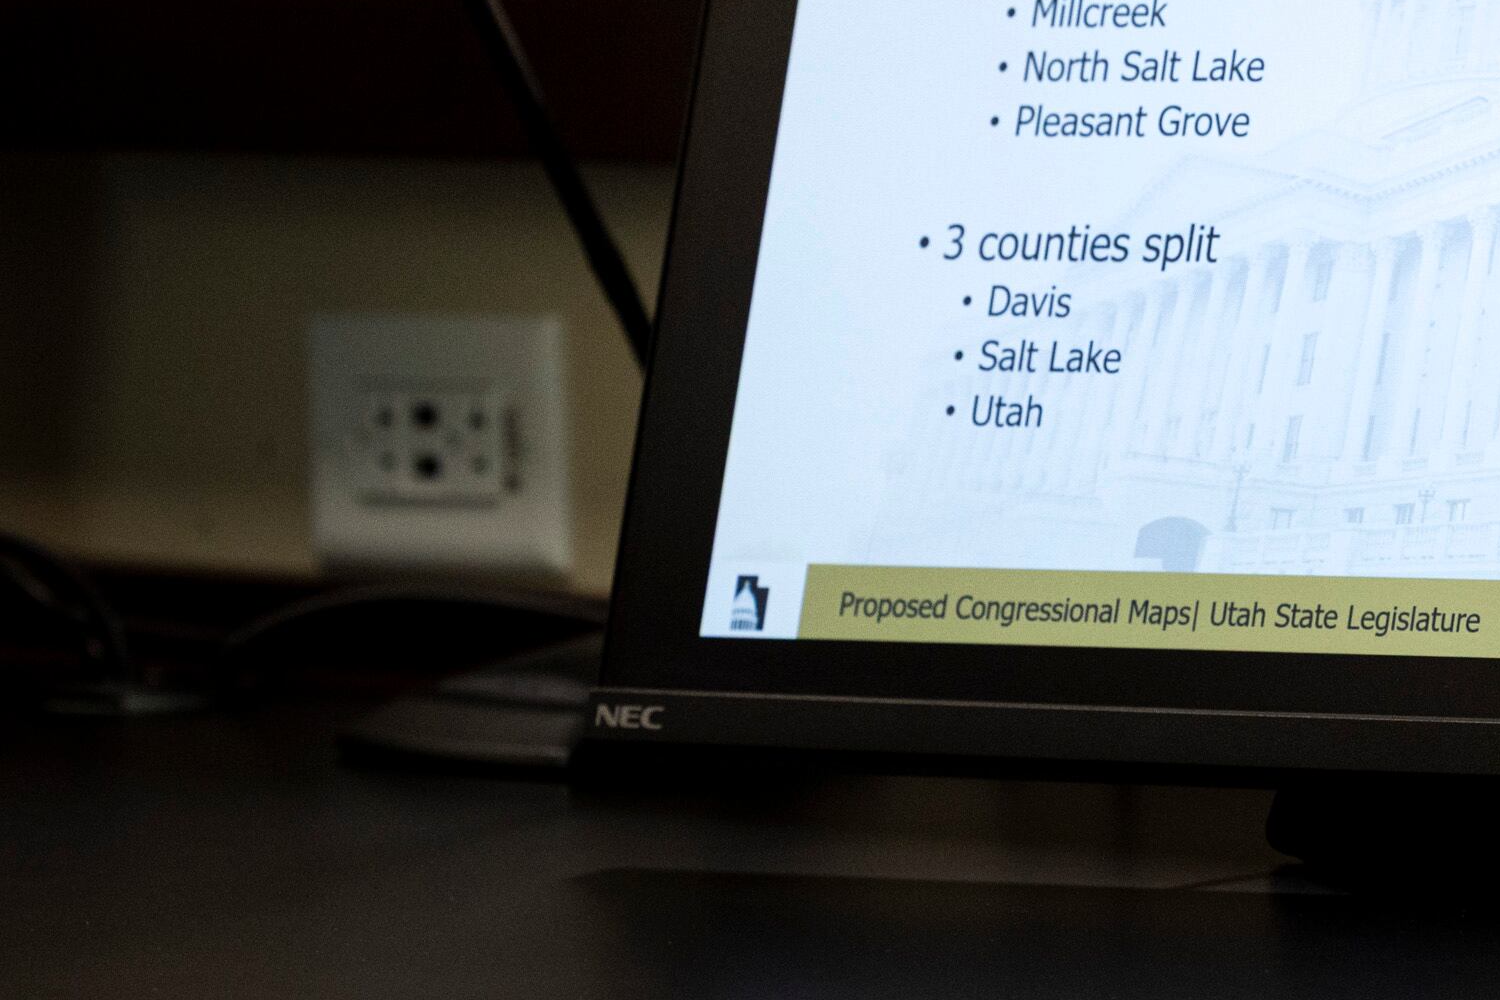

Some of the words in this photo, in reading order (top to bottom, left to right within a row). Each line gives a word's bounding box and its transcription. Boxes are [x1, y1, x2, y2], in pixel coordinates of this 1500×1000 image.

[1022, 50, 1109, 82] North
[1120, 50, 1181, 82] Salt
[1192, 49, 1265, 82] Lake
[1015, 105, 1147, 138] Pleasant
[1158, 105, 1250, 138] Grove
[943, 223, 966, 261] 3
[978, 224, 1131, 263] counties
[1142, 223, 1220, 271] split
[987, 285, 1072, 318] Davis
[978, 340, 1039, 374] Salt
[1048, 340, 1122, 374] Lake
[970, 394, 1044, 428] Utah
[839, 592, 948, 623] Proposed
[955, 594, 1120, 627] Congressional
[1209, 601, 1266, 628] Utah
[1274, 603, 1338, 630] State
[1346, 604, 1481, 634] Legislature
[594, 703, 666, 730] NEC
